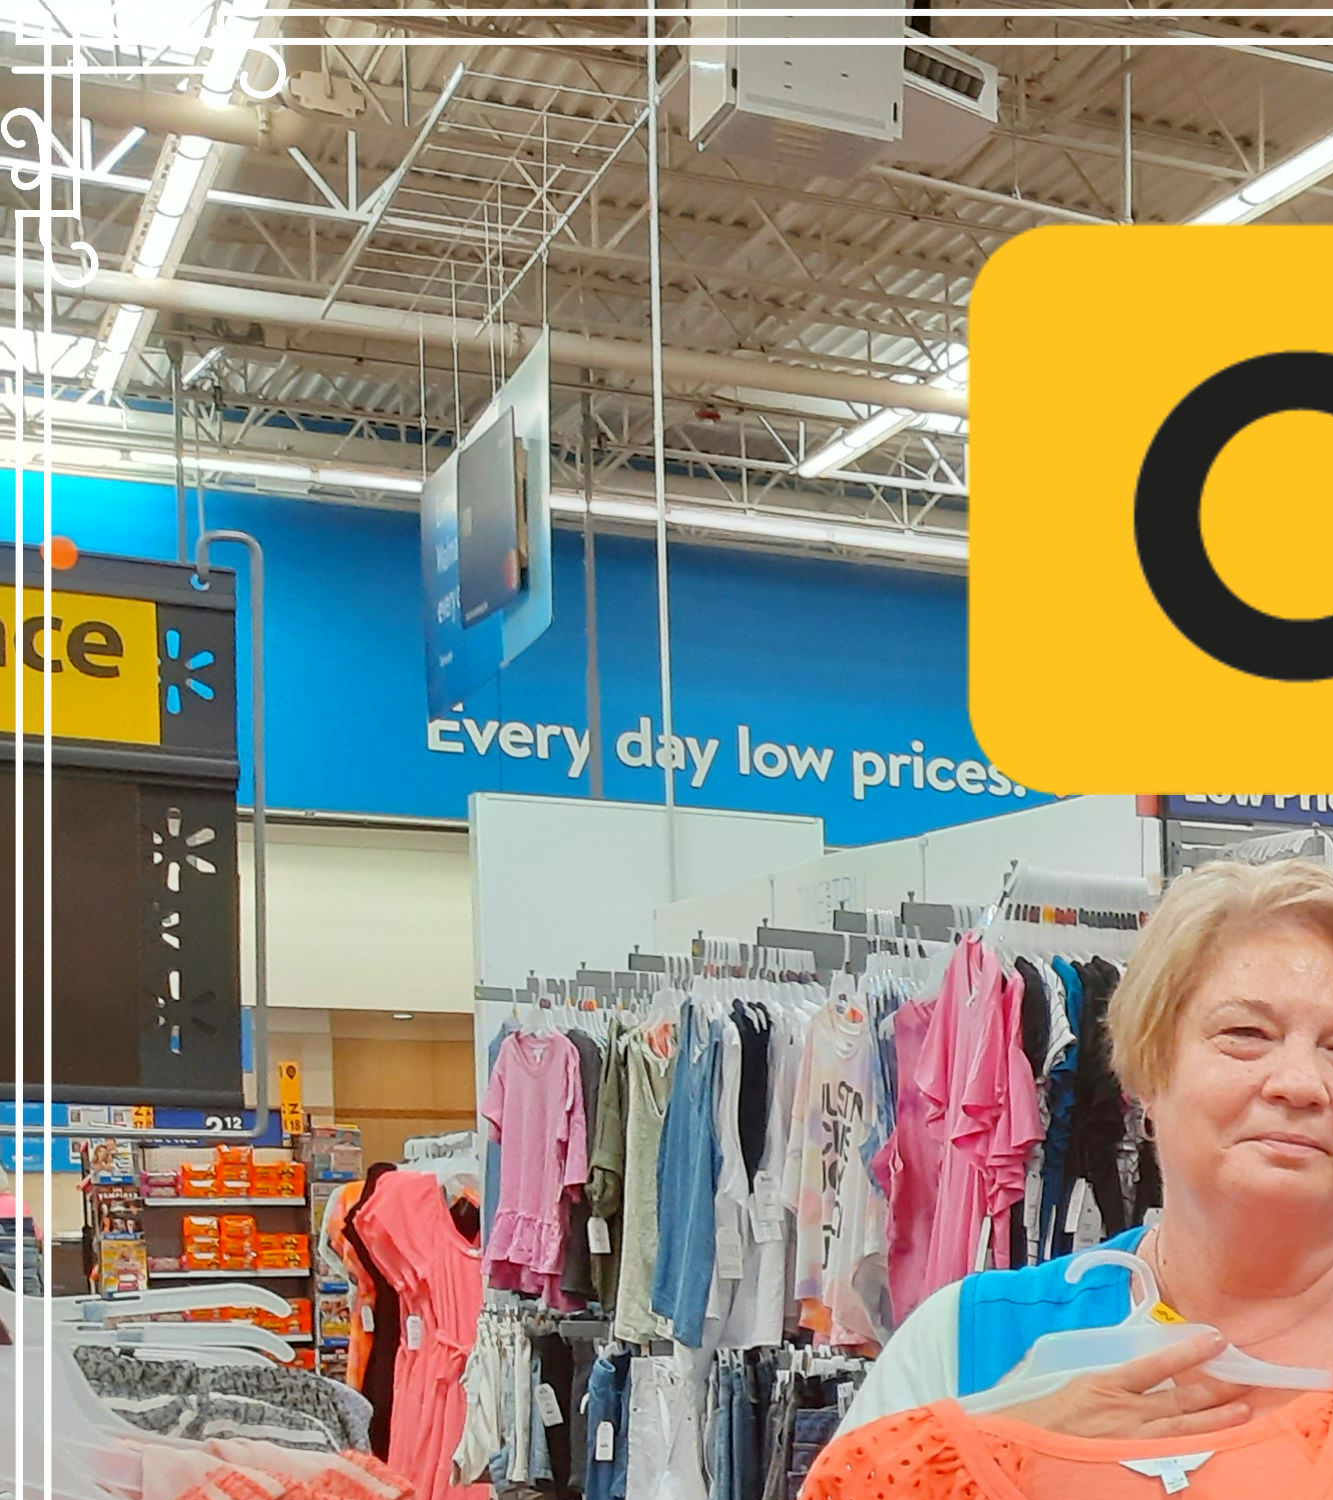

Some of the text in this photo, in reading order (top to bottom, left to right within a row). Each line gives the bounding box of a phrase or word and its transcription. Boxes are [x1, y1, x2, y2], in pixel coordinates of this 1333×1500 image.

[0, 612, 124, 678] ce
[616, 716, 719, 787] day
[738, 725, 834, 782] low
[853, 740, 1028, 800] prices.
